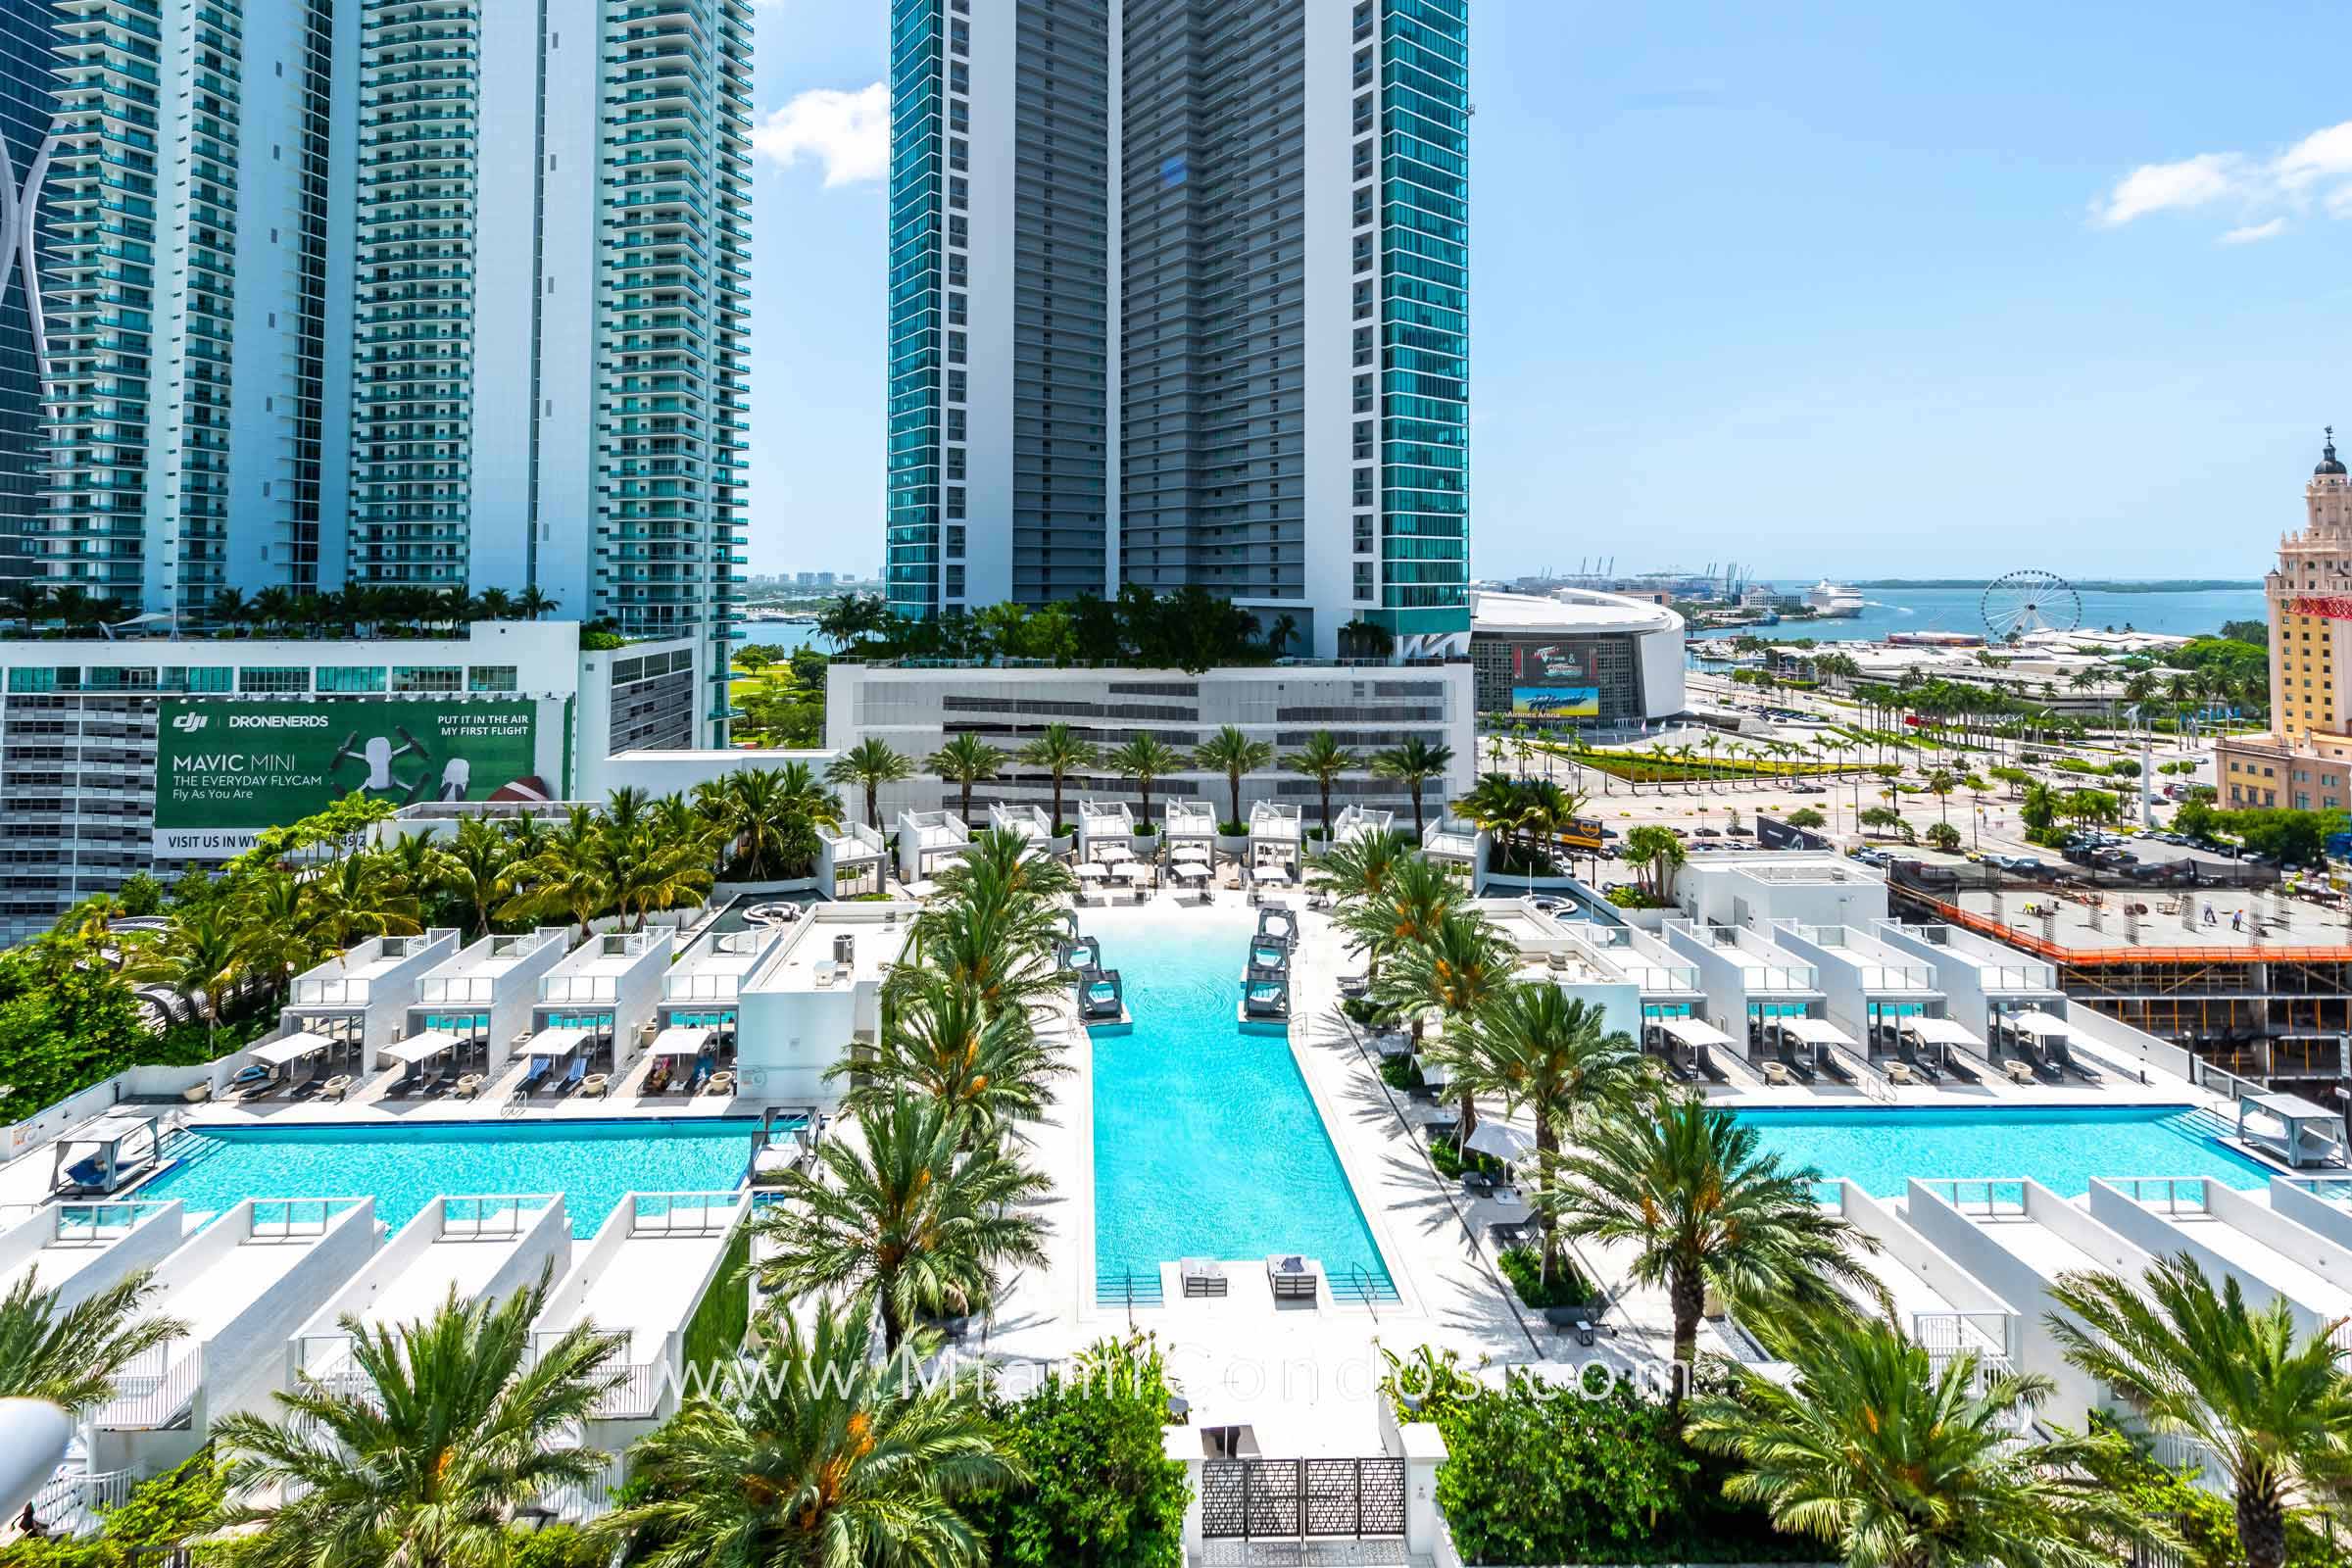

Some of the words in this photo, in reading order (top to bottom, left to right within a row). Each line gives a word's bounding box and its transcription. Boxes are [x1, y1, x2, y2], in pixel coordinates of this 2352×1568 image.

[228, 715, 329, 728] DRONENERDS
[438, 715, 459, 724] PUT
[461, 715, 471, 724] IT
[473, 715, 486, 724] IN
[488, 715, 509, 724] THE
[511, 715, 529, 724] AIR
[441, 727, 459, 736] MY
[461, 727, 489, 736] FIRST
[492, 726, 529, 736] FLIGHT
[172, 754, 244, 772] MAVIC
[251, 754, 296, 772] MINI
[172, 775, 198, 787] THE
[202, 775, 268, 787] EVERYDAY
[271, 775, 322, 786] FLYCAM
[172, 789, 189, 802] Fly
[191, 789, 206, 800] As
[209, 789, 230, 800] You
[233, 789, 254, 800] Are
[168, 835, 200, 848] VISIT
[202, 835, 220, 848] US
[222, 835, 236, 848] IN
